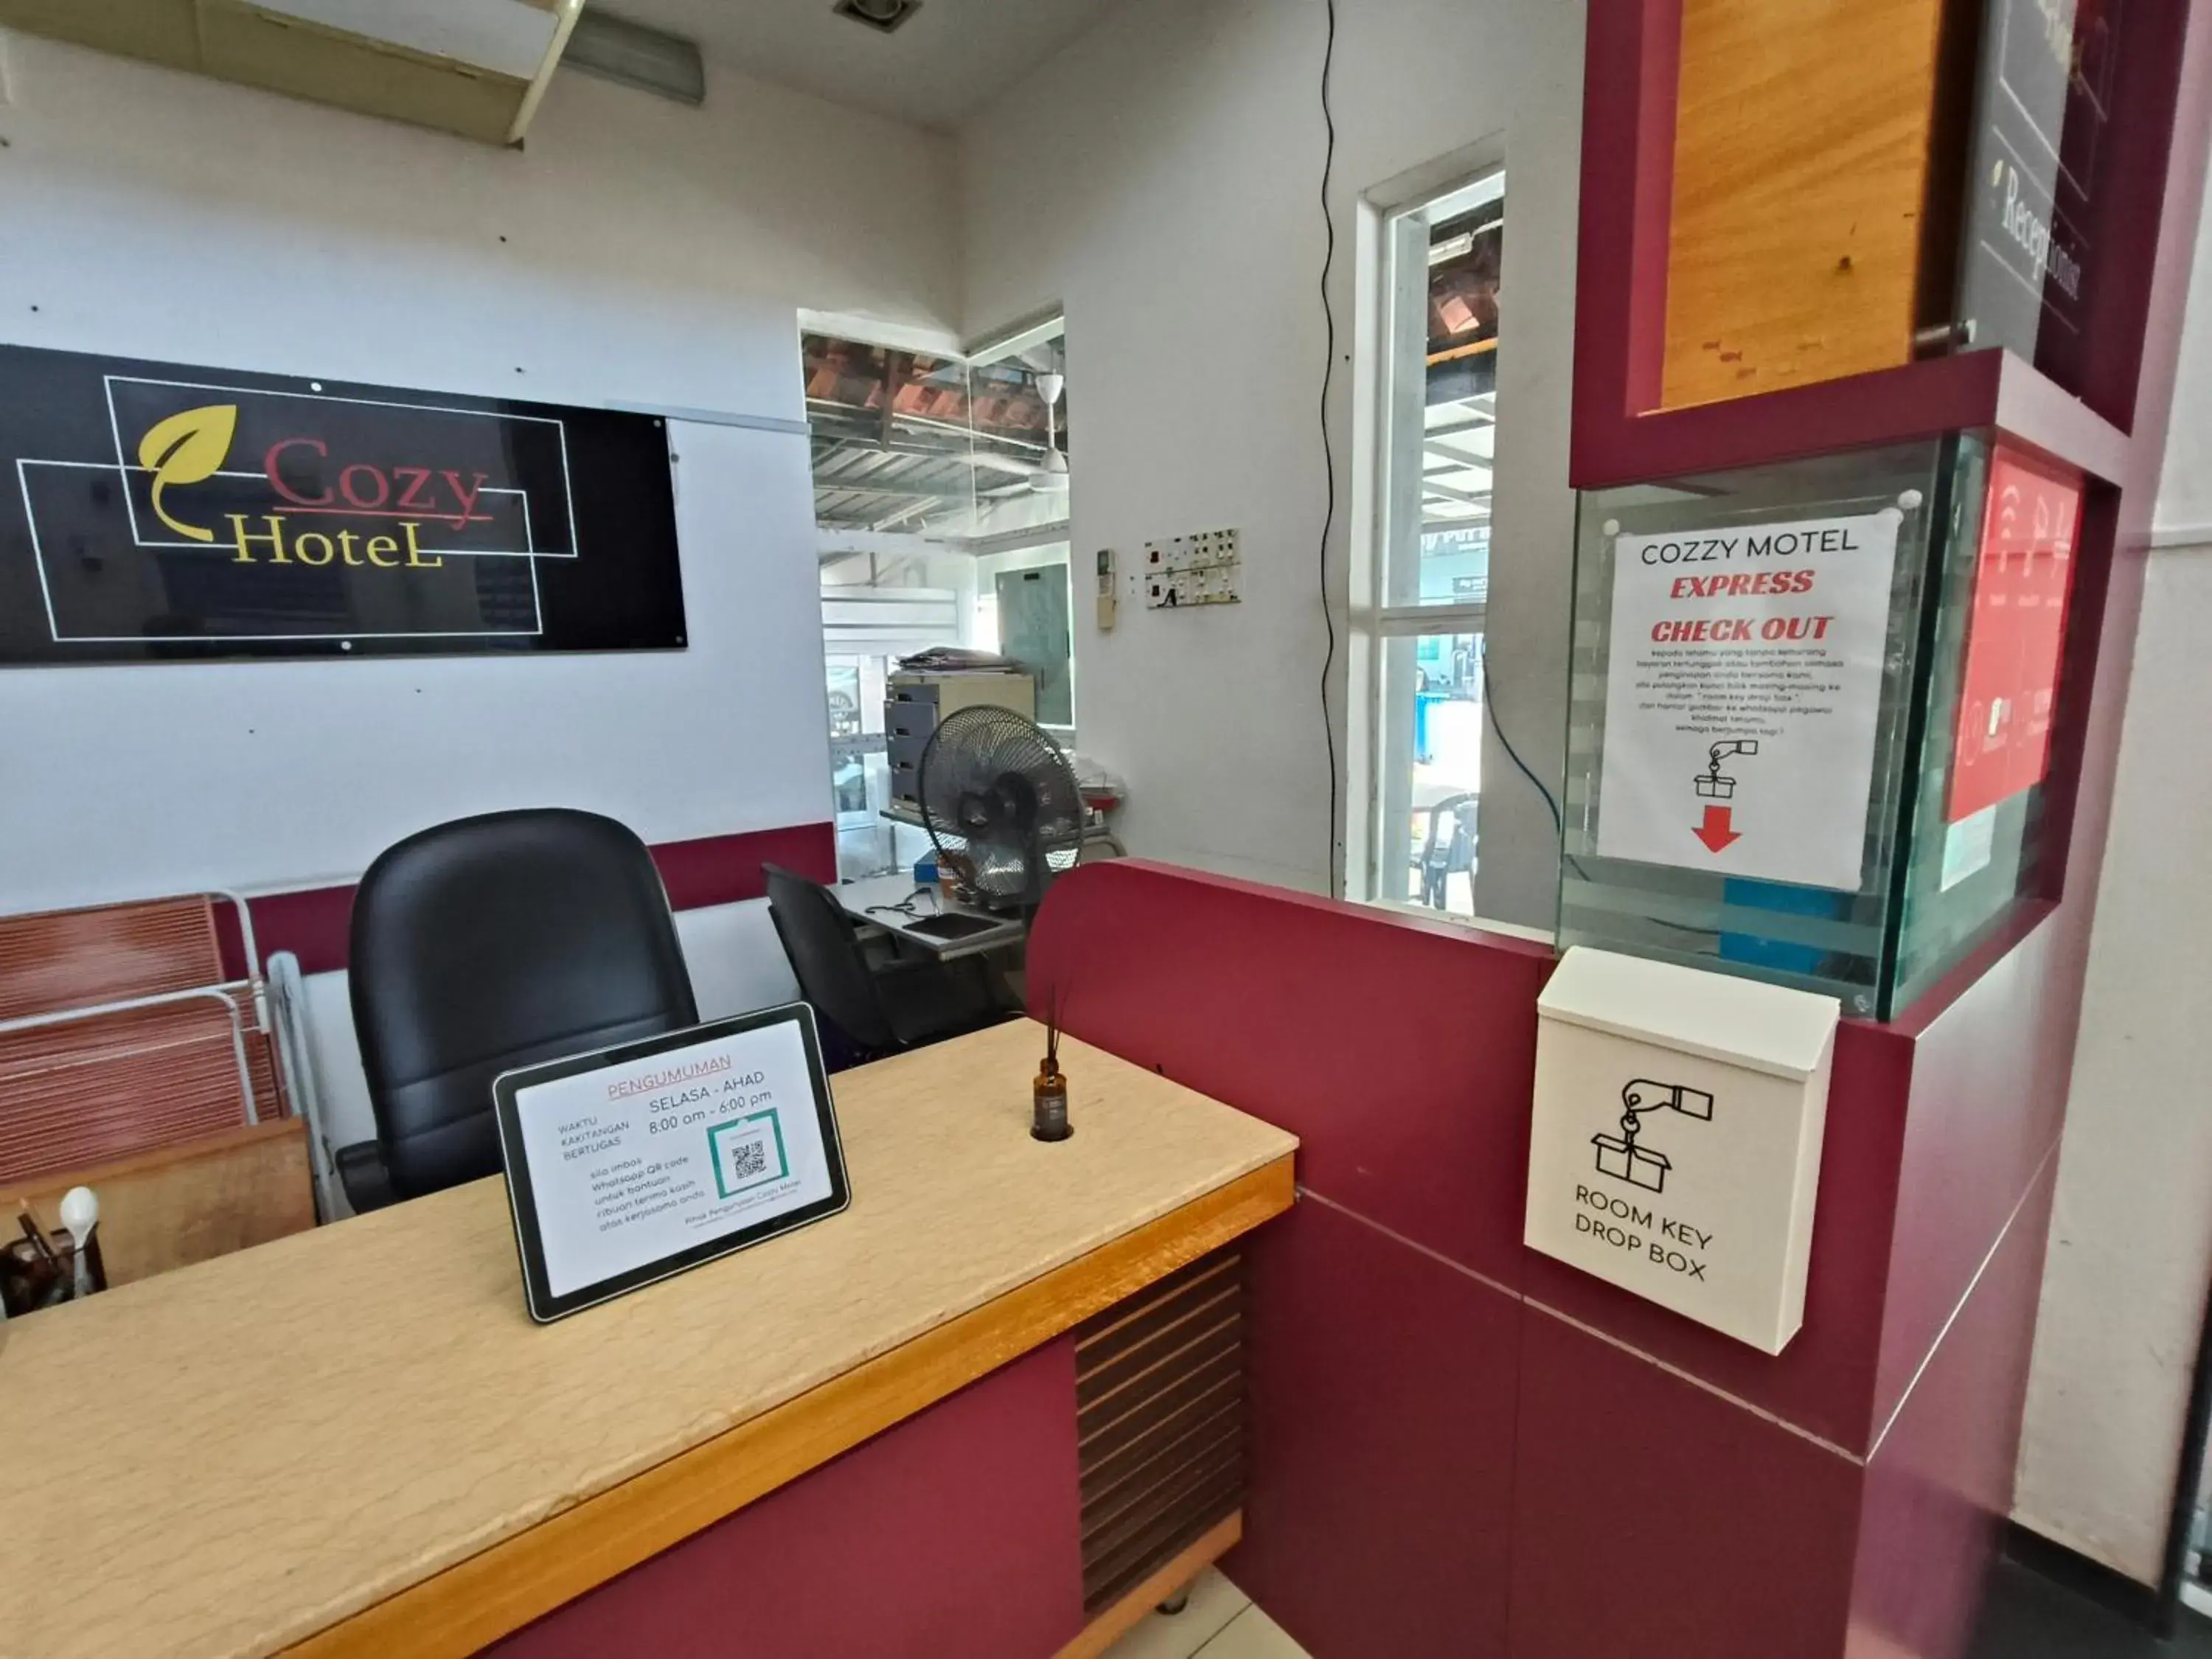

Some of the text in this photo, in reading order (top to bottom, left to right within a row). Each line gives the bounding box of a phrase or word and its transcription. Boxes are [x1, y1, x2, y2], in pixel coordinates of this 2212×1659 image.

[264, 437, 490, 531] Cozy
[1641, 529, 1860, 565] COZZY MOTEL
[1670, 569, 1816, 599] EXPRESS
[1651, 616, 1835, 642] CHECK OUT
[608, 1054, 732, 1098] PENGUMUMAN
[649, 1087, 711, 1114] SELASA
[723, 1071, 765, 1093] AHAD
[648, 1116, 678, 1135] 8:00
[682, 1110, 706, 1124] am
[750, 1090, 773, 1107] pm
[1576, 1184, 1713, 1251] ROOM KEY
[1575, 1213, 1707, 1282] DROP BOX
